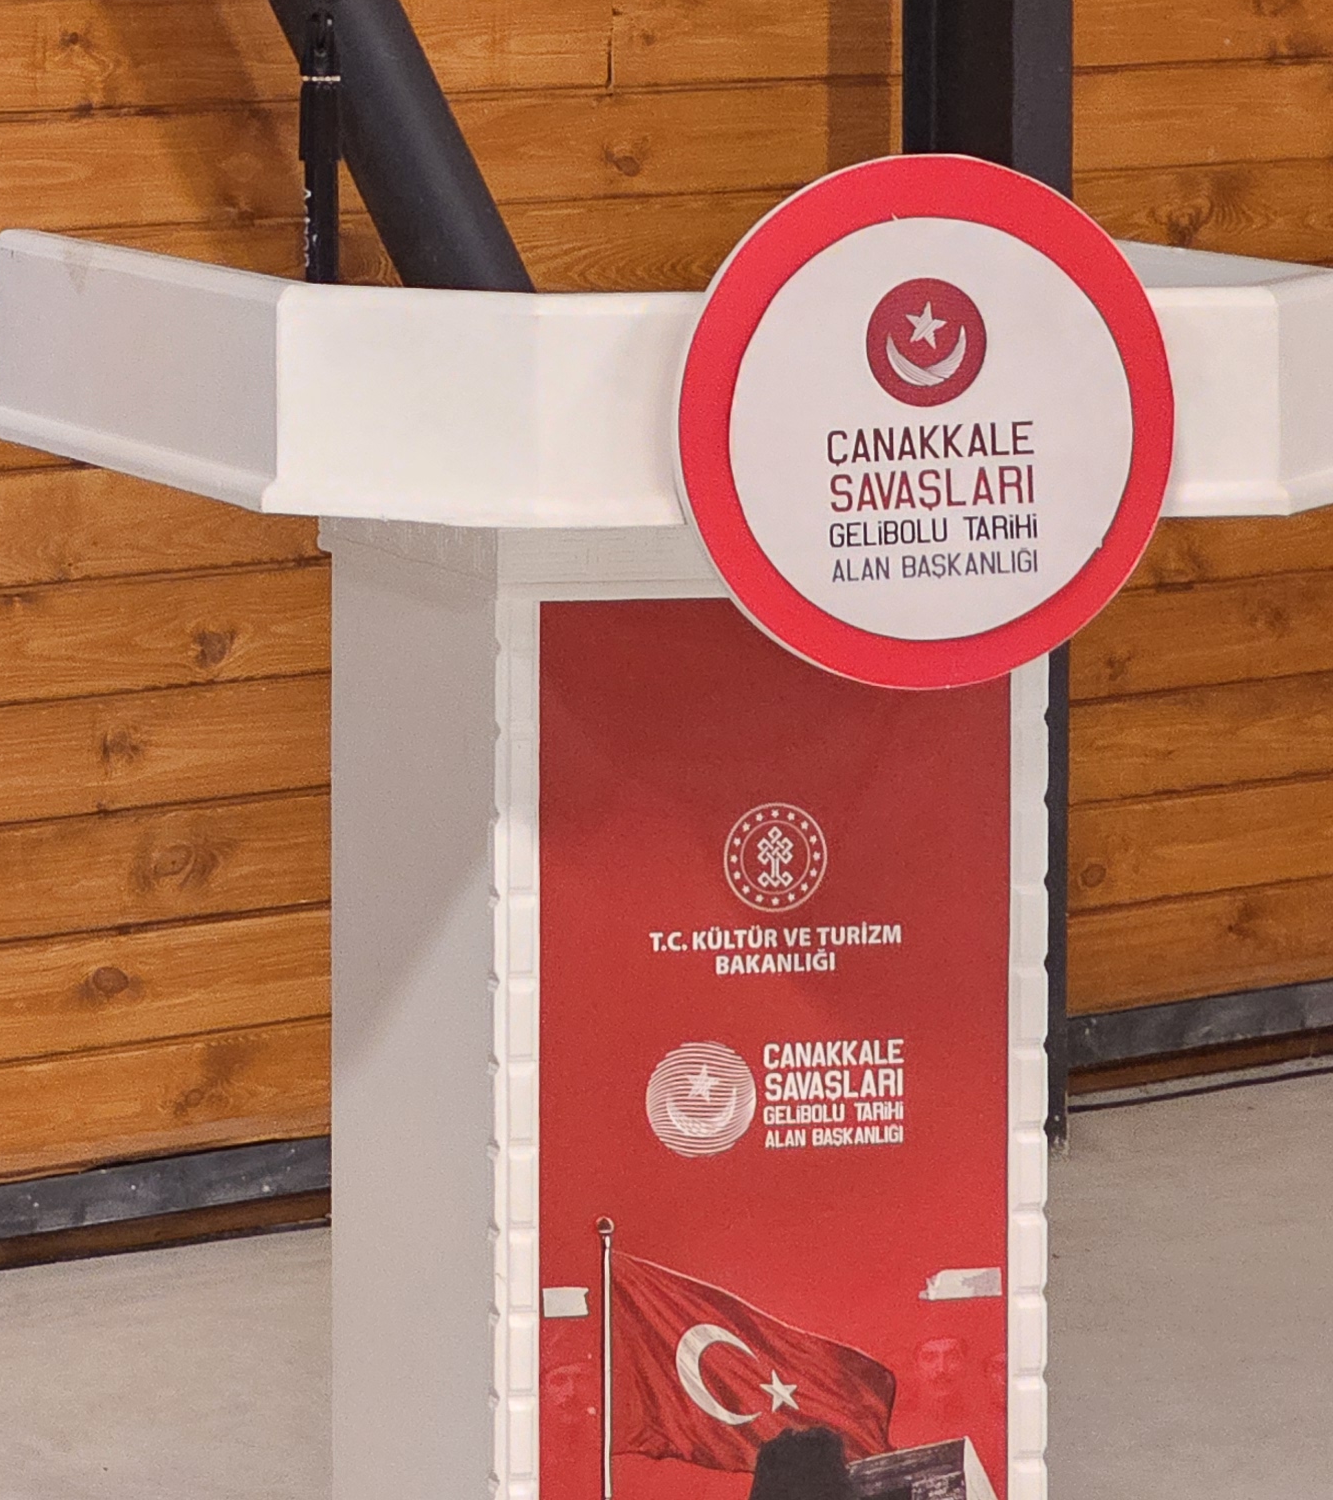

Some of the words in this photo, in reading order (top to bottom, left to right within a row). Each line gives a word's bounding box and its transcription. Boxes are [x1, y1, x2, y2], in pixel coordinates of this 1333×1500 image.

[827, 421, 1034, 466] ÇANAKKALE
[830, 465, 1034, 512] SAVAŞLARI
[829, 517, 947, 547] GELİBOLU
[963, 513, 1038, 541] TARİHİ
[832, 556, 890, 582] ALAN
[902, 547, 1038, 579] BAŞKANLIĞI
[649, 931, 687, 951] T.C.
[692, 926, 777, 950] KÜLTÜR
[784, 928, 811, 946] VE
[817, 921, 902, 945] TURİZM
[715, 948, 835, 975] BAKANLIĞI
[764, 1068, 904, 1101] SAVAŞLARI
[765, 1129, 806, 1148] ALAN
